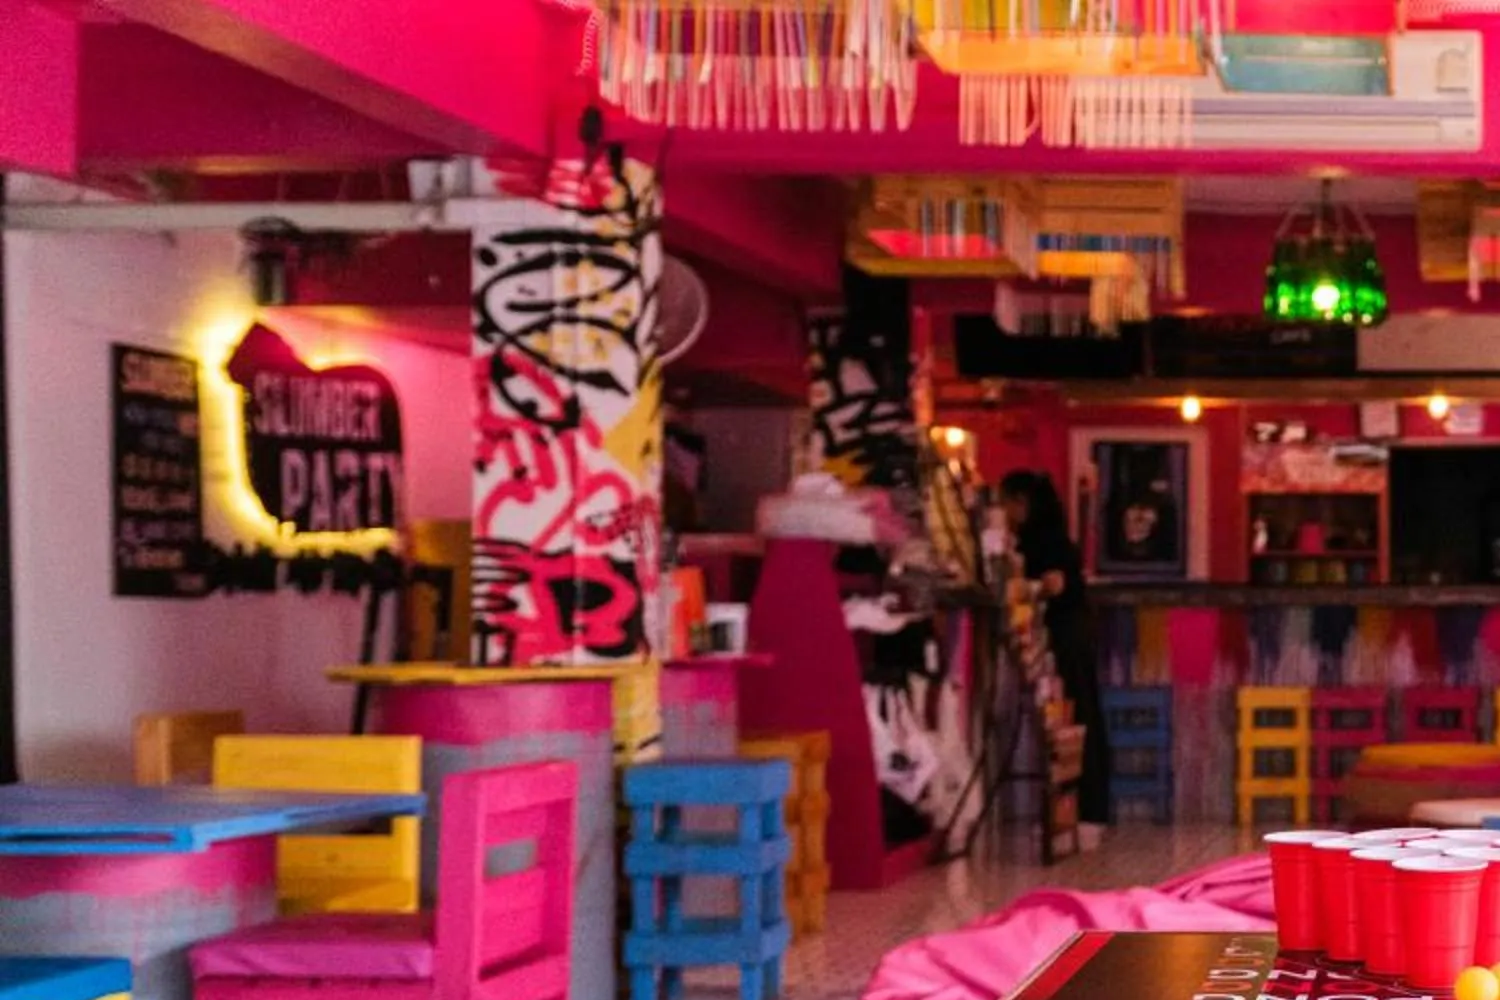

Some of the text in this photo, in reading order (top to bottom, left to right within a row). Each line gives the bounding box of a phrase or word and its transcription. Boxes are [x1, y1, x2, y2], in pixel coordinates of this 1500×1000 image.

[254, 370, 380, 441] SLUMBER
[281, 449, 401, 533] PARTY
[1201, 981, 1379, 993] ONG
